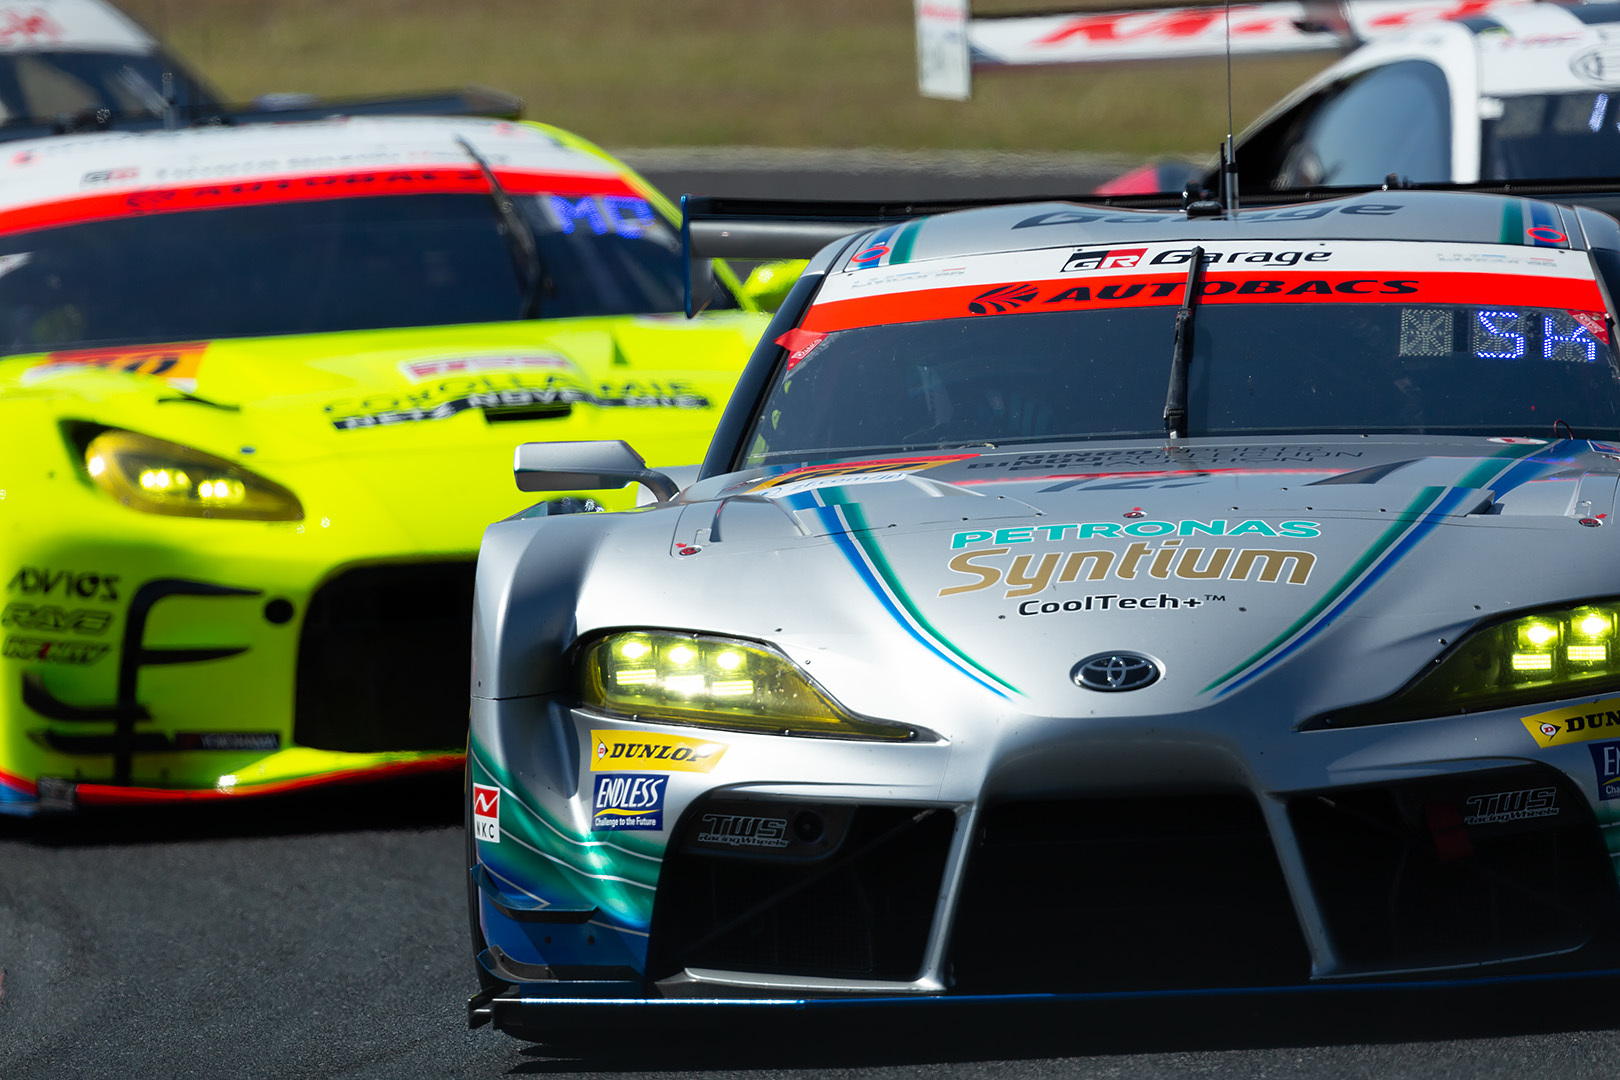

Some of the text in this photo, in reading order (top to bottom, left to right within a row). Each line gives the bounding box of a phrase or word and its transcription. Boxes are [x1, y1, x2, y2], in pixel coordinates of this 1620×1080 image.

[1061, 249, 1333, 272] GR Garage
[1043, 279, 1419, 305] AUTOBACS
[951, 519, 1322, 550] PETRONAS
[938, 539, 1318, 598] Syntium
[609, 743, 711, 762] DUNLOP
[597, 779, 664, 808] ENDLESS
[1467, 787, 1556, 817] TWS
[477, 821, 495, 839] NKC
[595, 816, 656, 827] Challenge to the Future
[702, 813, 787, 840] TWS
